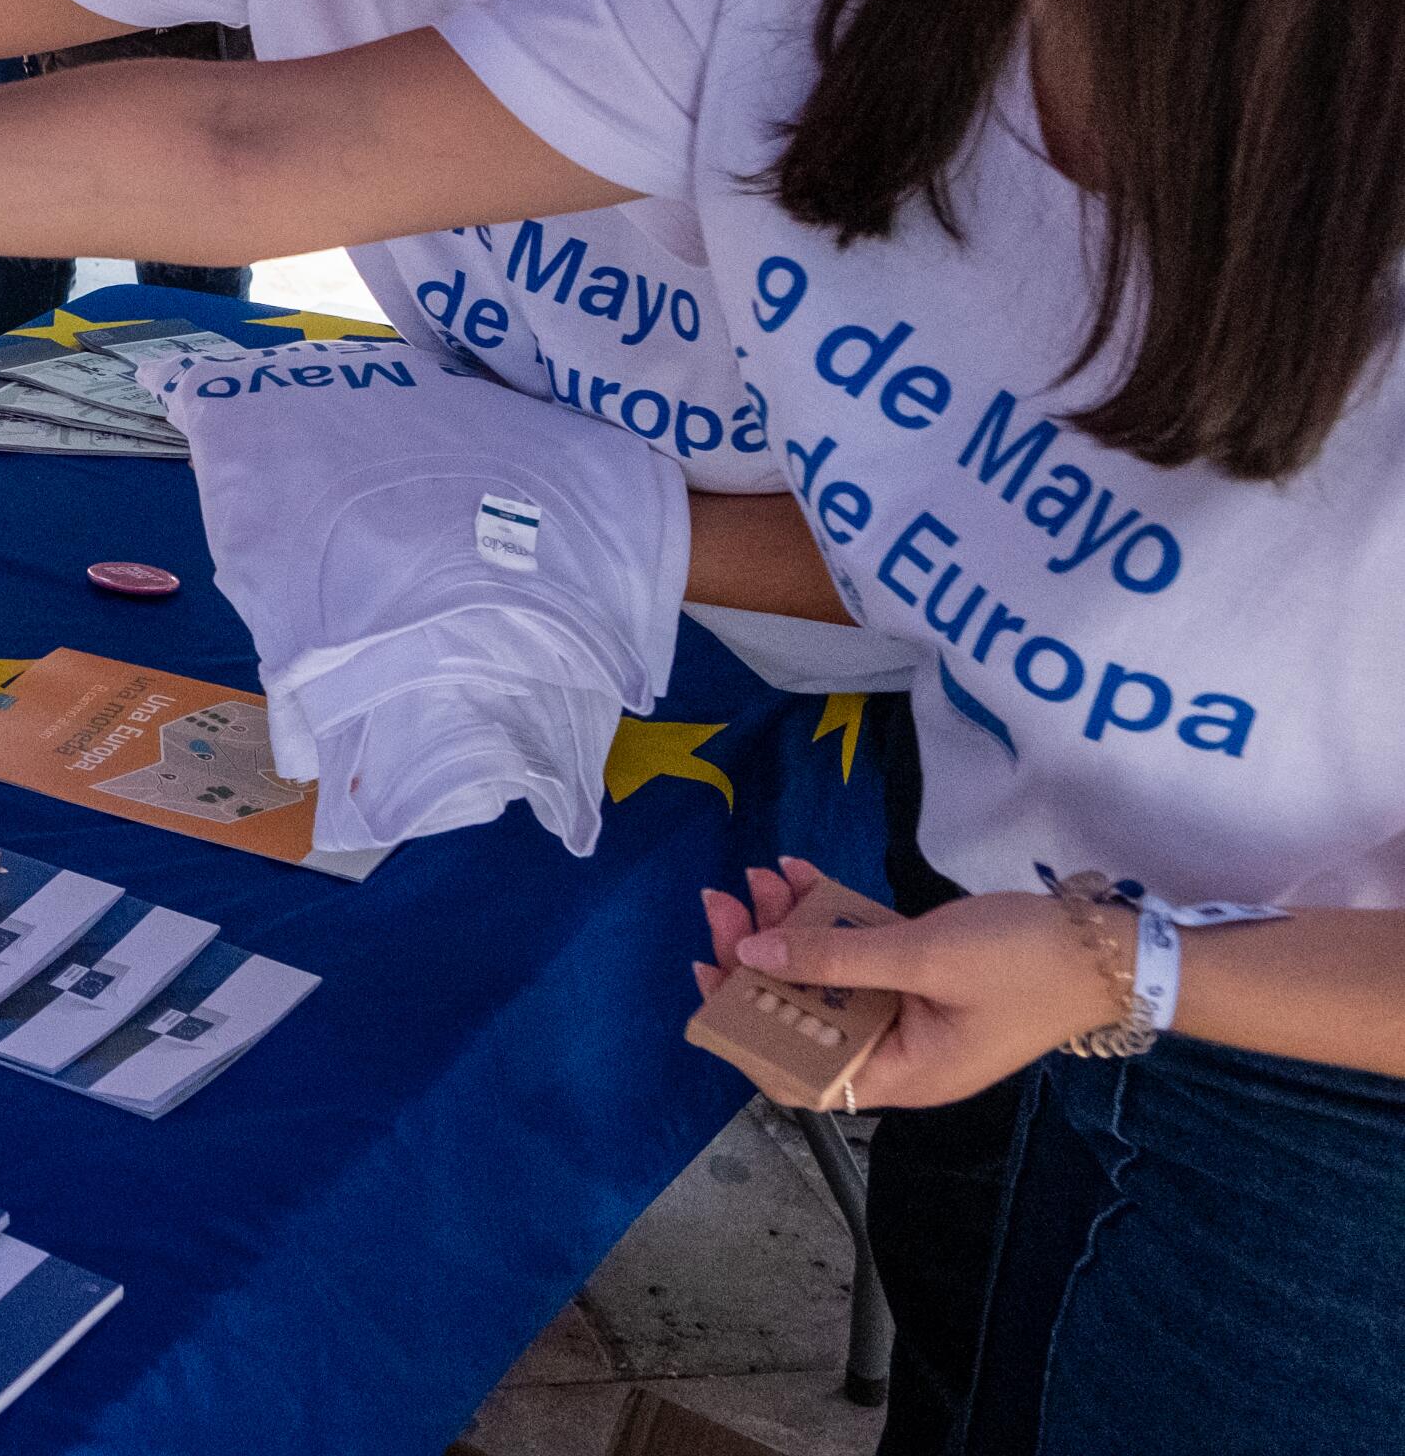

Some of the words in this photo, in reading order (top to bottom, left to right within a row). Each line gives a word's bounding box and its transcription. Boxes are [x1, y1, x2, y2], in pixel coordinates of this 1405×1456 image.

[506, 219, 700, 346] Mayo
[196, 360, 418, 399] Mayo
[417, 270, 509, 349] de
[534, 334, 769, 459] uropa
[752, 255, 808, 333] 9
[815, 321, 951, 430] de
[958, 391, 1182, 597] Mayo
[786, 435, 873, 544] de
[878, 510, 1257, 758] Europa
[127, 694, 177, 723] Una
